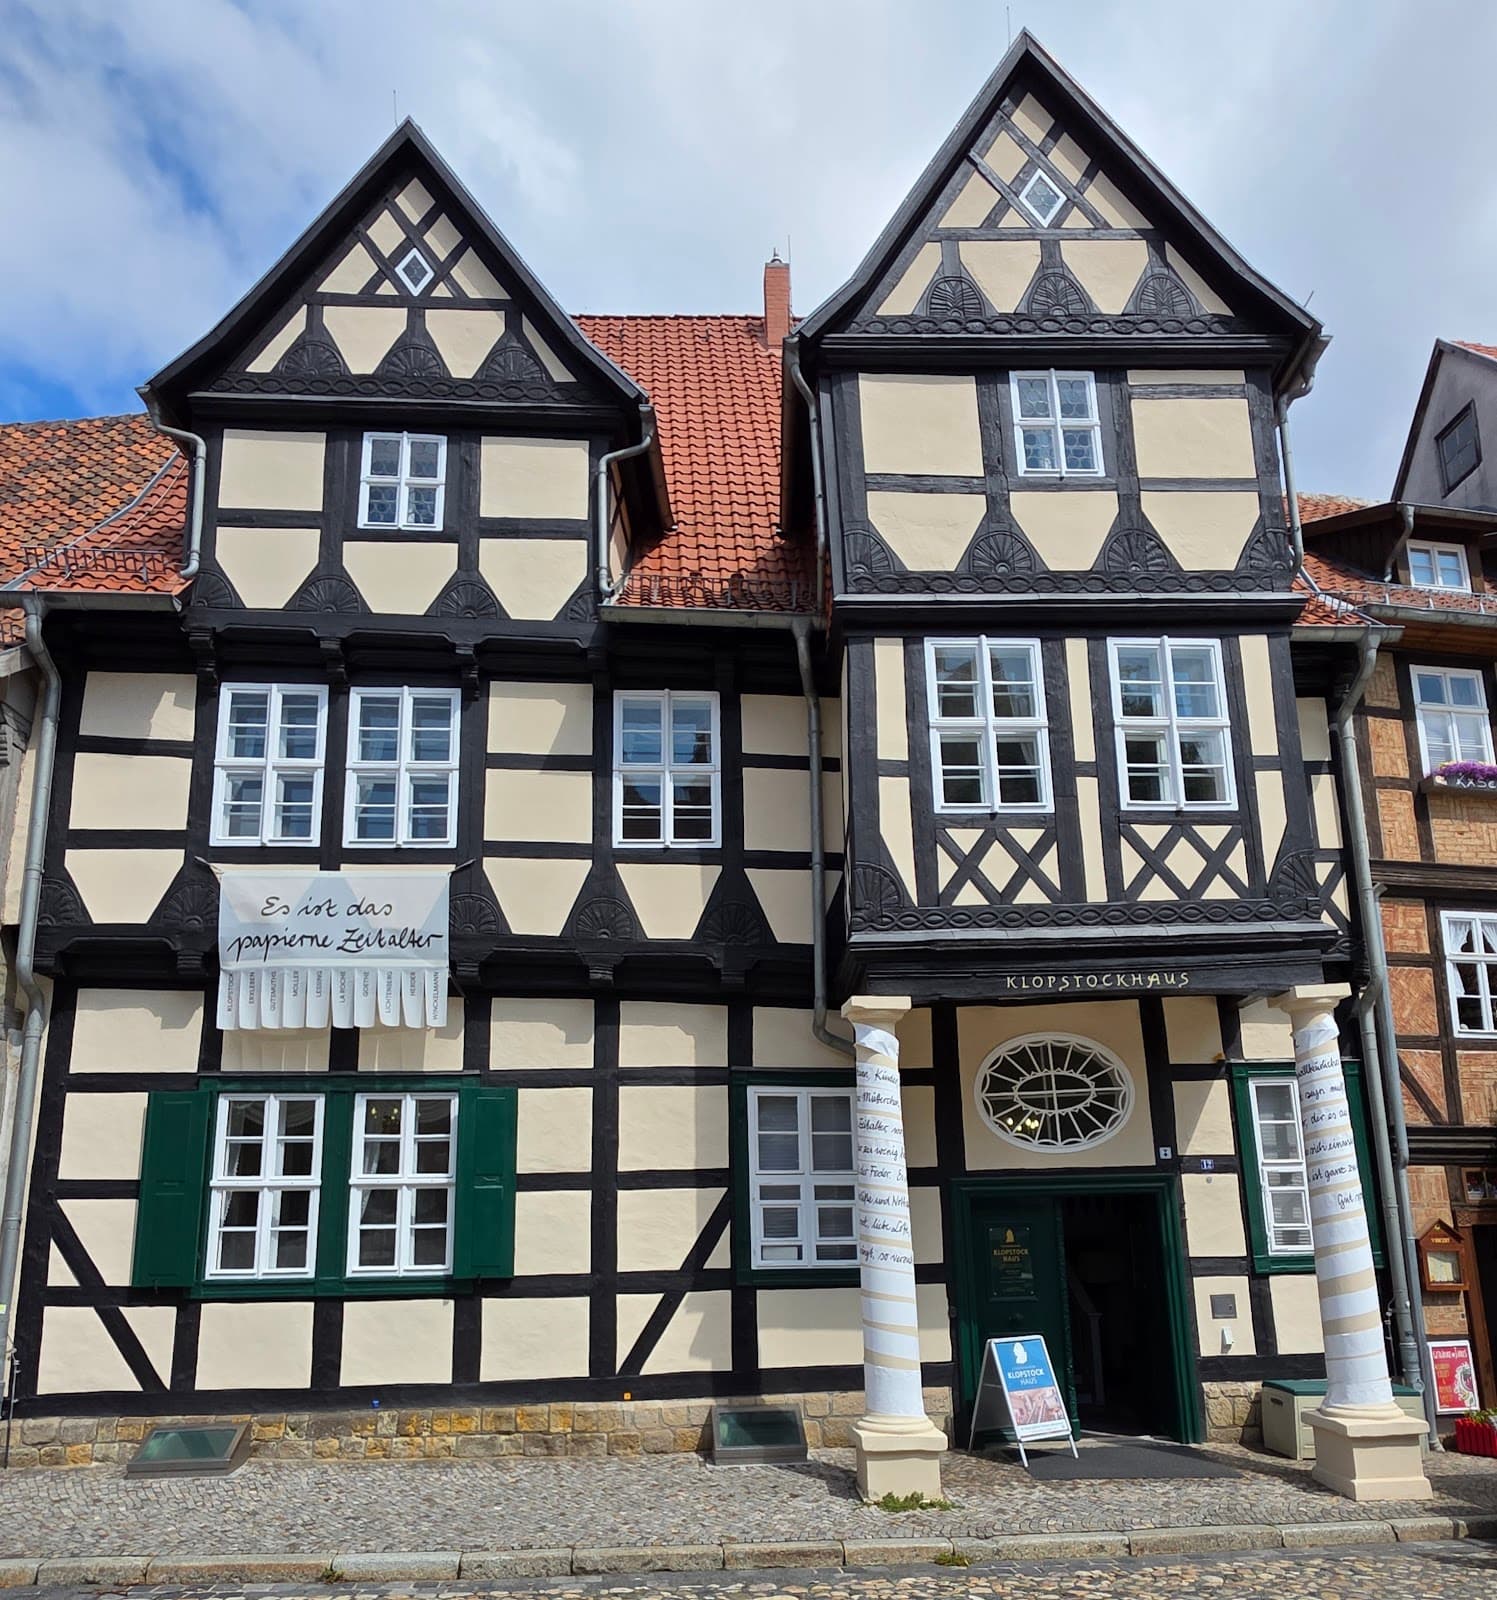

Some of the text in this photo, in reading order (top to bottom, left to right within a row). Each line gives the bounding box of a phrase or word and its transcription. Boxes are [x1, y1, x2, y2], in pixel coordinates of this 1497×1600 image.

[260, 896, 392, 917] Es ist das
[227, 927, 444, 962] papierne Zeitalter
[248, 971, 256, 1004] ERXLEBEN
[384, 971, 392, 1014] LICHTENBERG
[1006, 972, 1189, 992] KLOPSTOCKHAUS
[431, 971, 439, 1021] WINCKELMANN
[993, 1248, 1029, 1256] KLOPSTOCK
[1008, 1368, 1045, 1379] KLOPSTOCK
